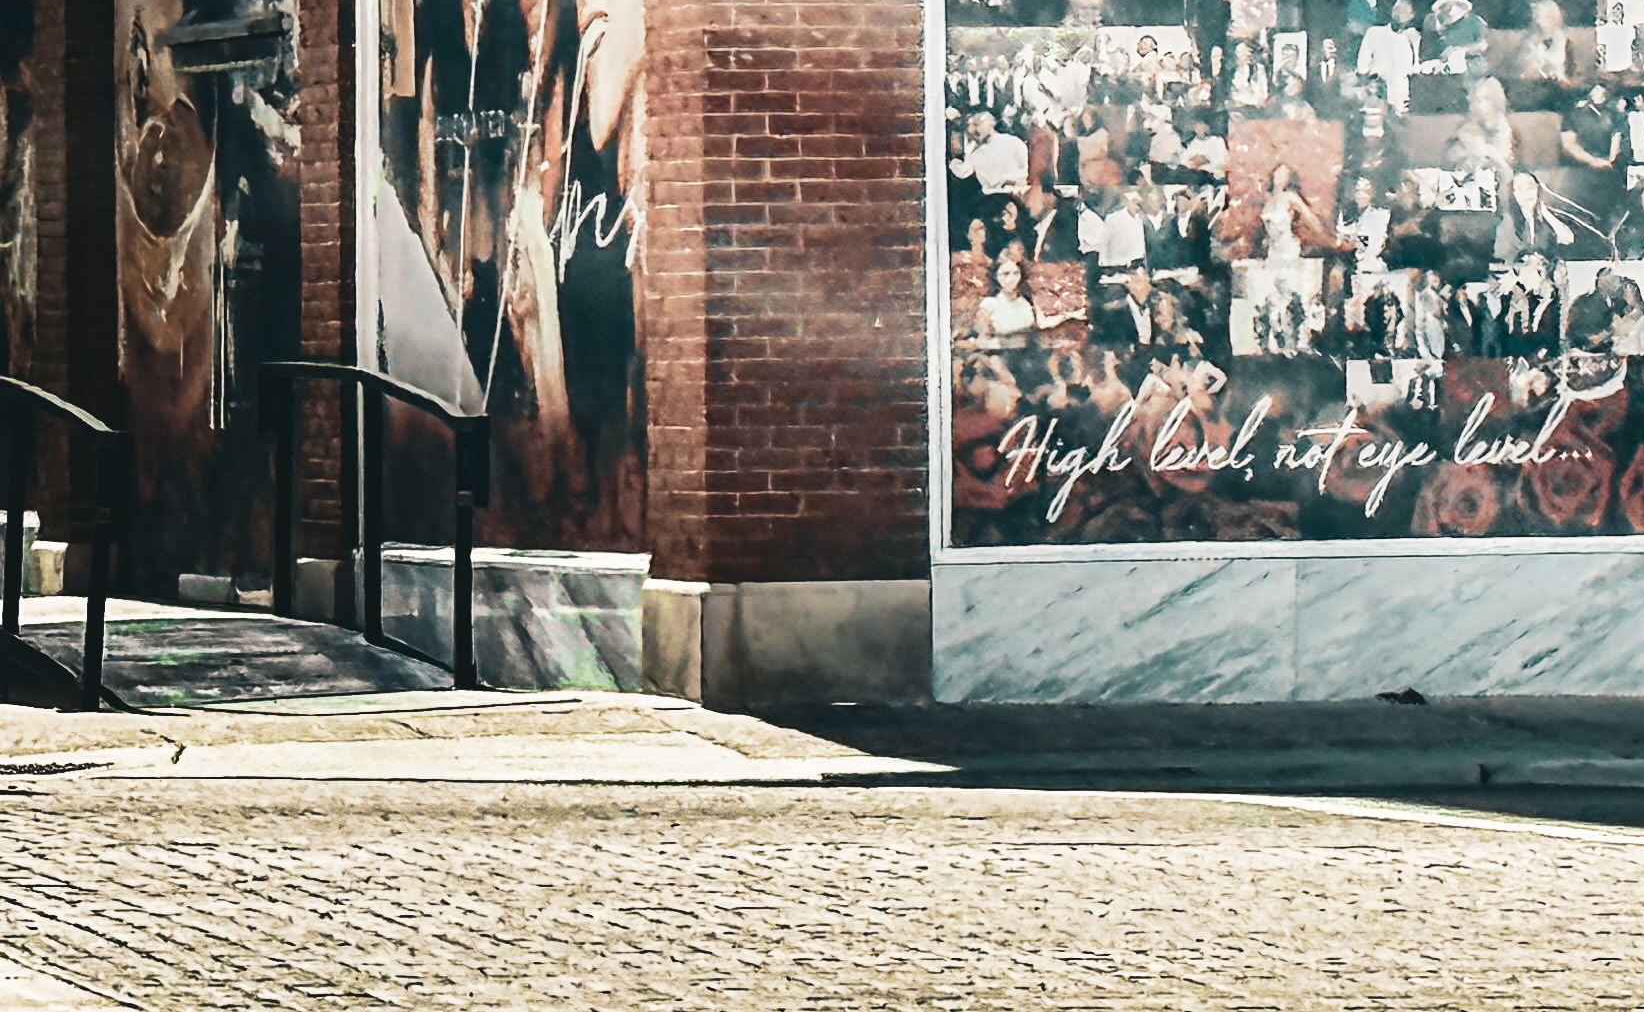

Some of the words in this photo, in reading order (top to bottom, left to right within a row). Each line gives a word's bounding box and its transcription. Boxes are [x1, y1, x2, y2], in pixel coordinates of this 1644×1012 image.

[997, 397, 1133, 524] High
[1273, 407, 1369, 495] not
[1358, 440, 1437, 519] eye
